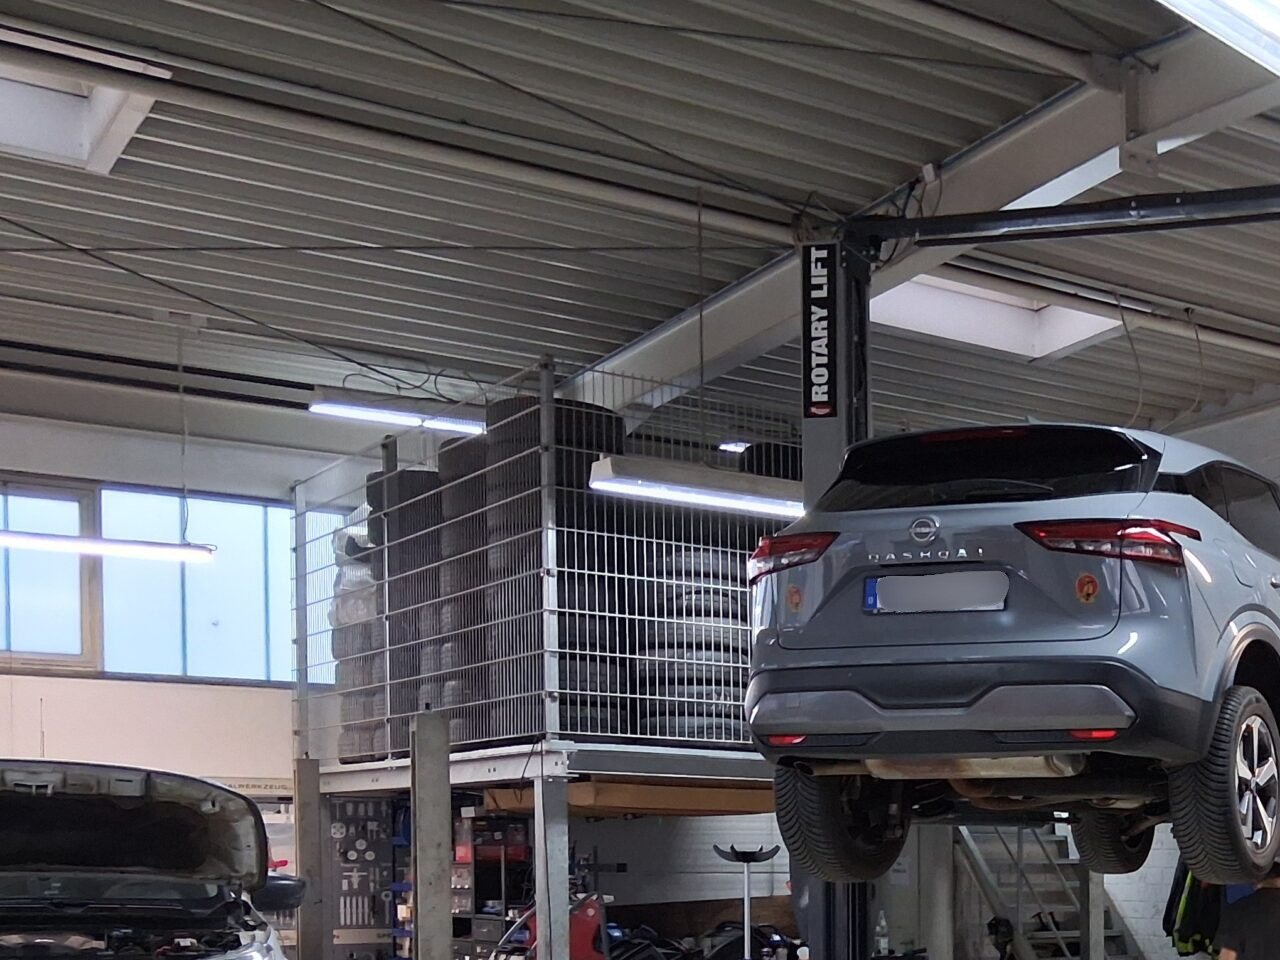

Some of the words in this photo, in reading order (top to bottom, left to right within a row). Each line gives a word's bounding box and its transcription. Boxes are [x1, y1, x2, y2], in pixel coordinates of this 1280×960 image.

[810, 246, 829, 299] LIFT
[811, 305, 829, 402] ROTARY
[867, 547, 984, 562] QASHQAI
